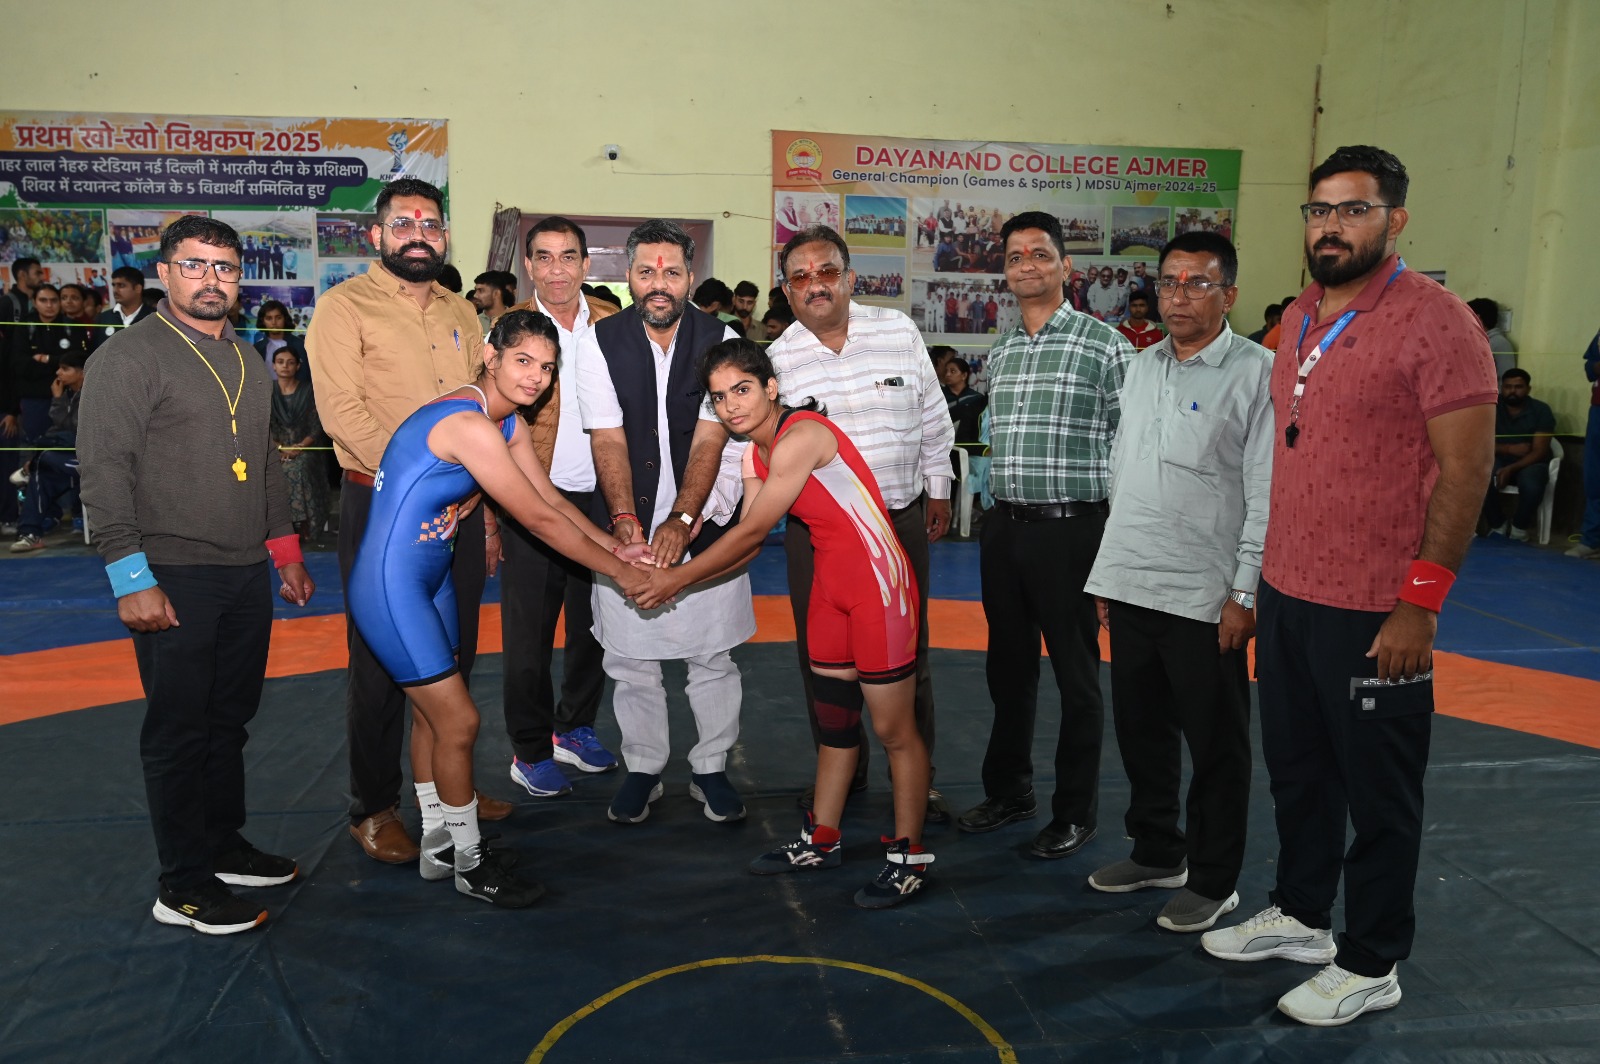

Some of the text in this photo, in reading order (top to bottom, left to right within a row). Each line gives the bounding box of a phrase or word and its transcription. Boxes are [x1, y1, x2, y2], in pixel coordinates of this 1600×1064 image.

[16, 121, 321, 152] प्रथम खो-खो विश्वकप 2025
[0, 158, 21, 172] ाहर
[24, 159, 56, 172] लाल
[92, 157, 141, 173] स्टेडियम
[144, 158, 162, 174] नई
[165, 158, 205, 175] दिल्ली
[208, 158, 219, 175] में
[222, 159, 268, 175] भारतीय
[271, 160, 294, 176] टीम
[297, 160, 311, 176] के
[313, 161, 363, 177] प्रशिक्षण
[856, 146, 1208, 177] DAYANAND COLLEGE AJMER
[21, 176, 326, 199] शिवर में दयानन्द कॉलेज के 5 विद्यार्थी सम्मिलित हुए
[832, 169, 886, 182] General
[889, 172, 959, 187] Champion
[963, 173, 1015, 189] (Games
[1018, 177, 1027, 188] &
[1031, 178, 1072, 192] Sports
[1085, 179, 1121, 191] MDSU
[1124, 181, 1162, 193] Ajmer
[1165, 181, 1216, 193] 2024-25
